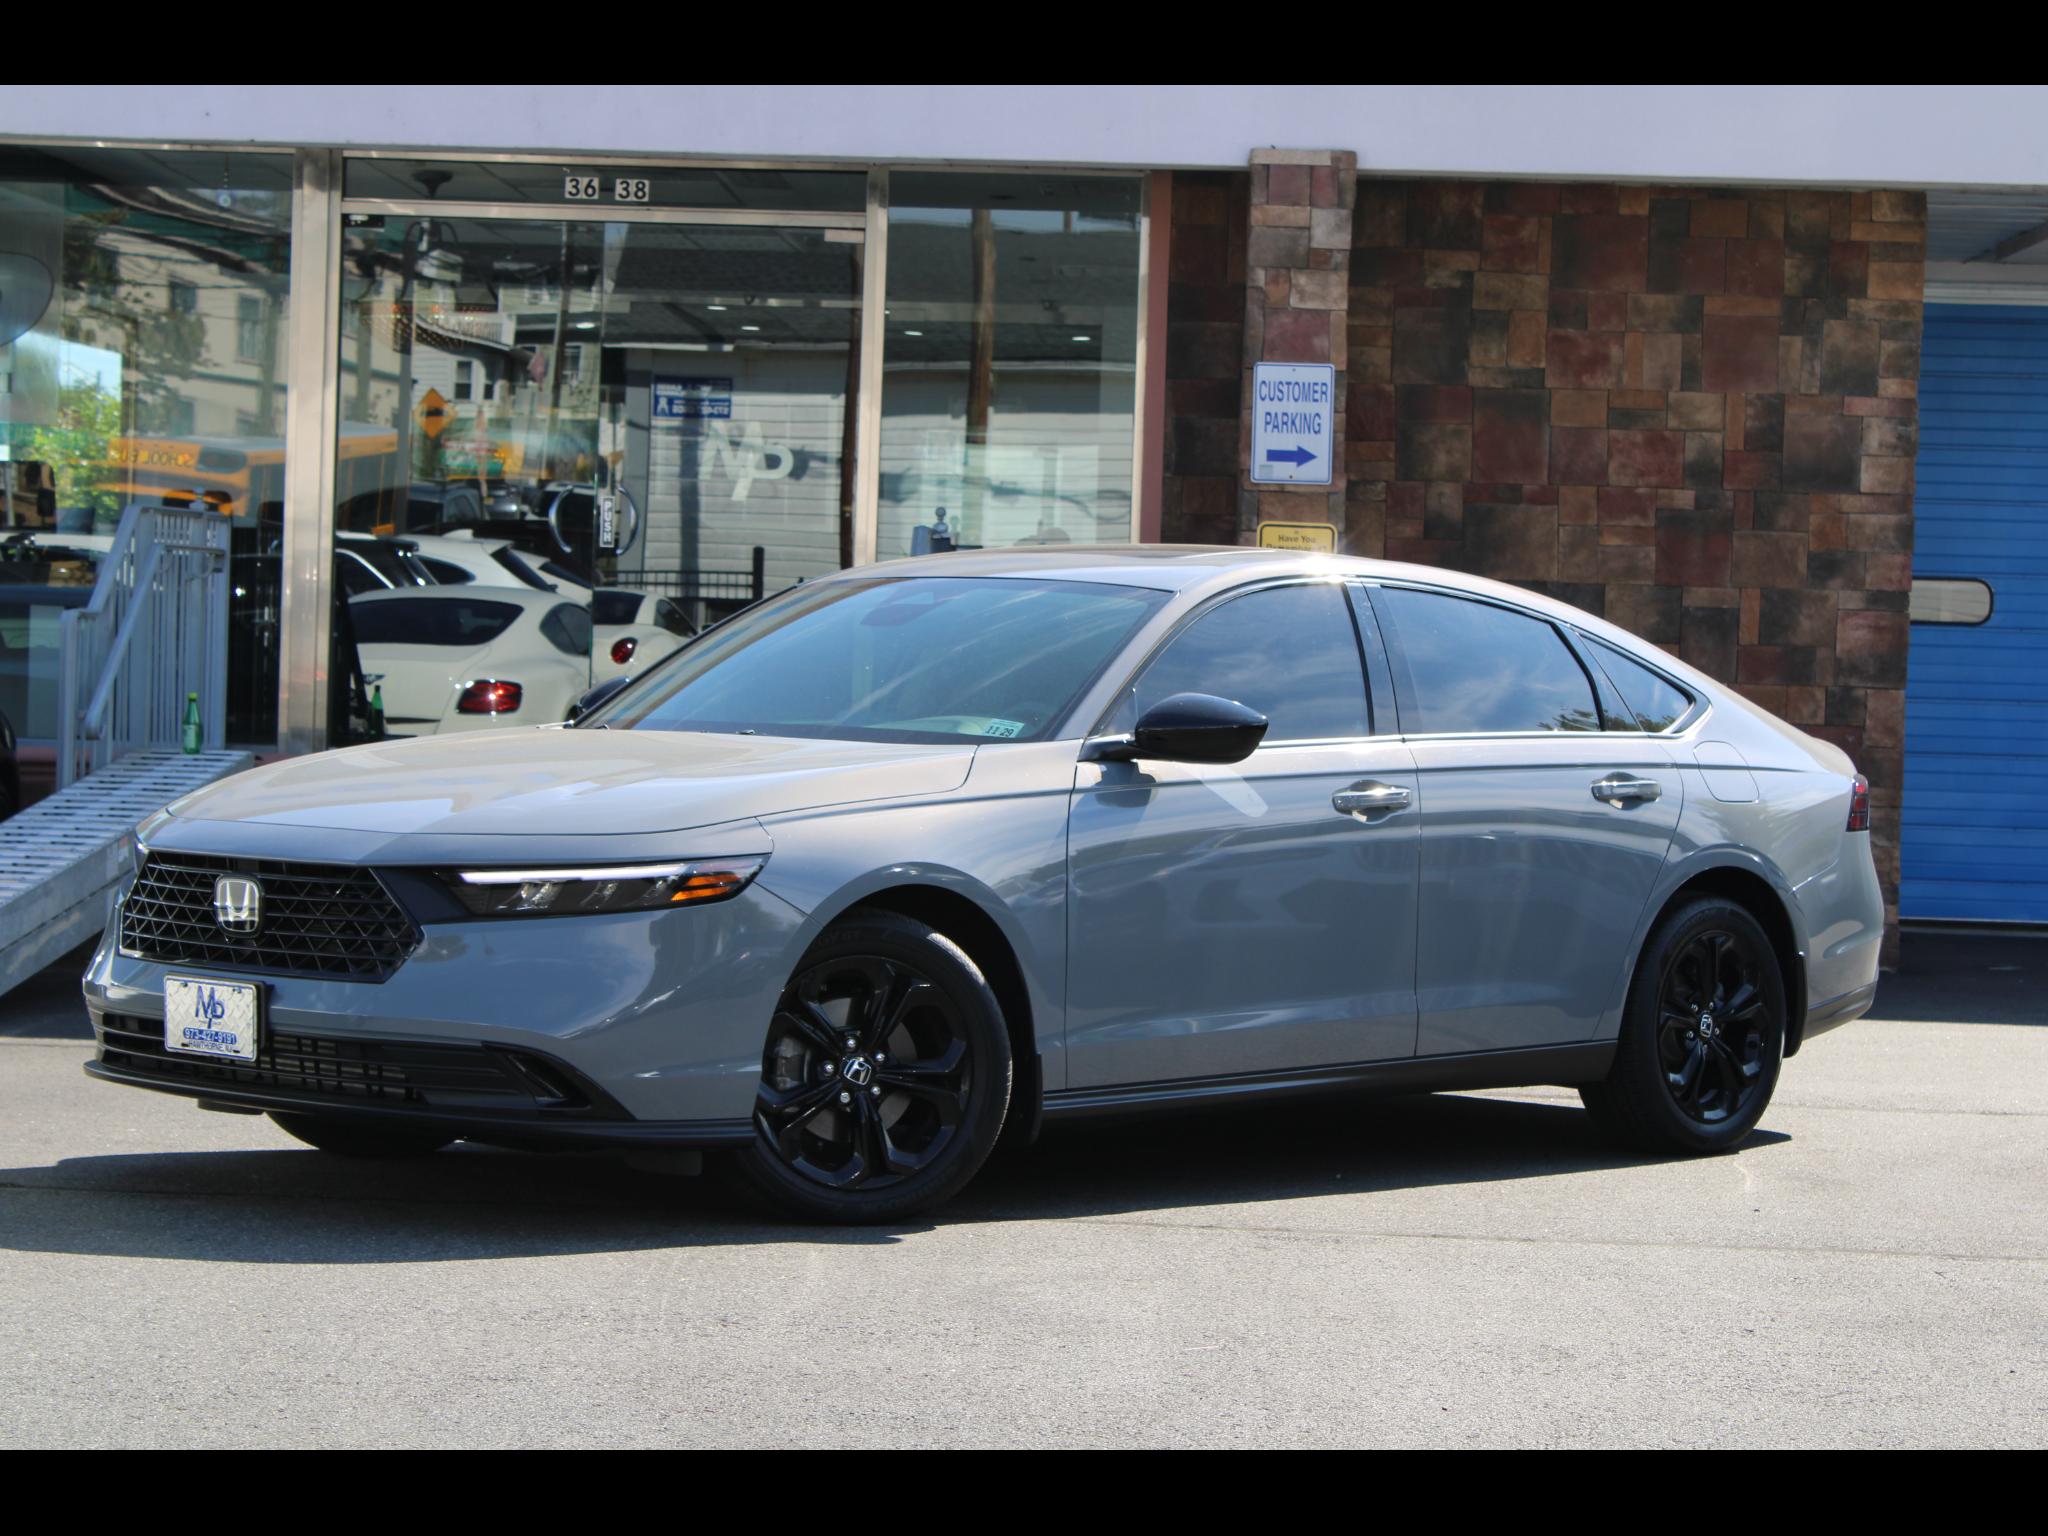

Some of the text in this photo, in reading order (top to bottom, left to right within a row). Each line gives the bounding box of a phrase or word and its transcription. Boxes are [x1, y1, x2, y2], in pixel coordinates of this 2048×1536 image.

[567, 178, 647, 200] 36 38
[1258, 380, 1329, 403] CUSTOMER
[1263, 412, 1322, 435] PARKING
[603, 500, 613, 543] PUSH
[1278, 534, 1317, 544] Have You
[184, 1028, 236, 1045] 973-427-9191
